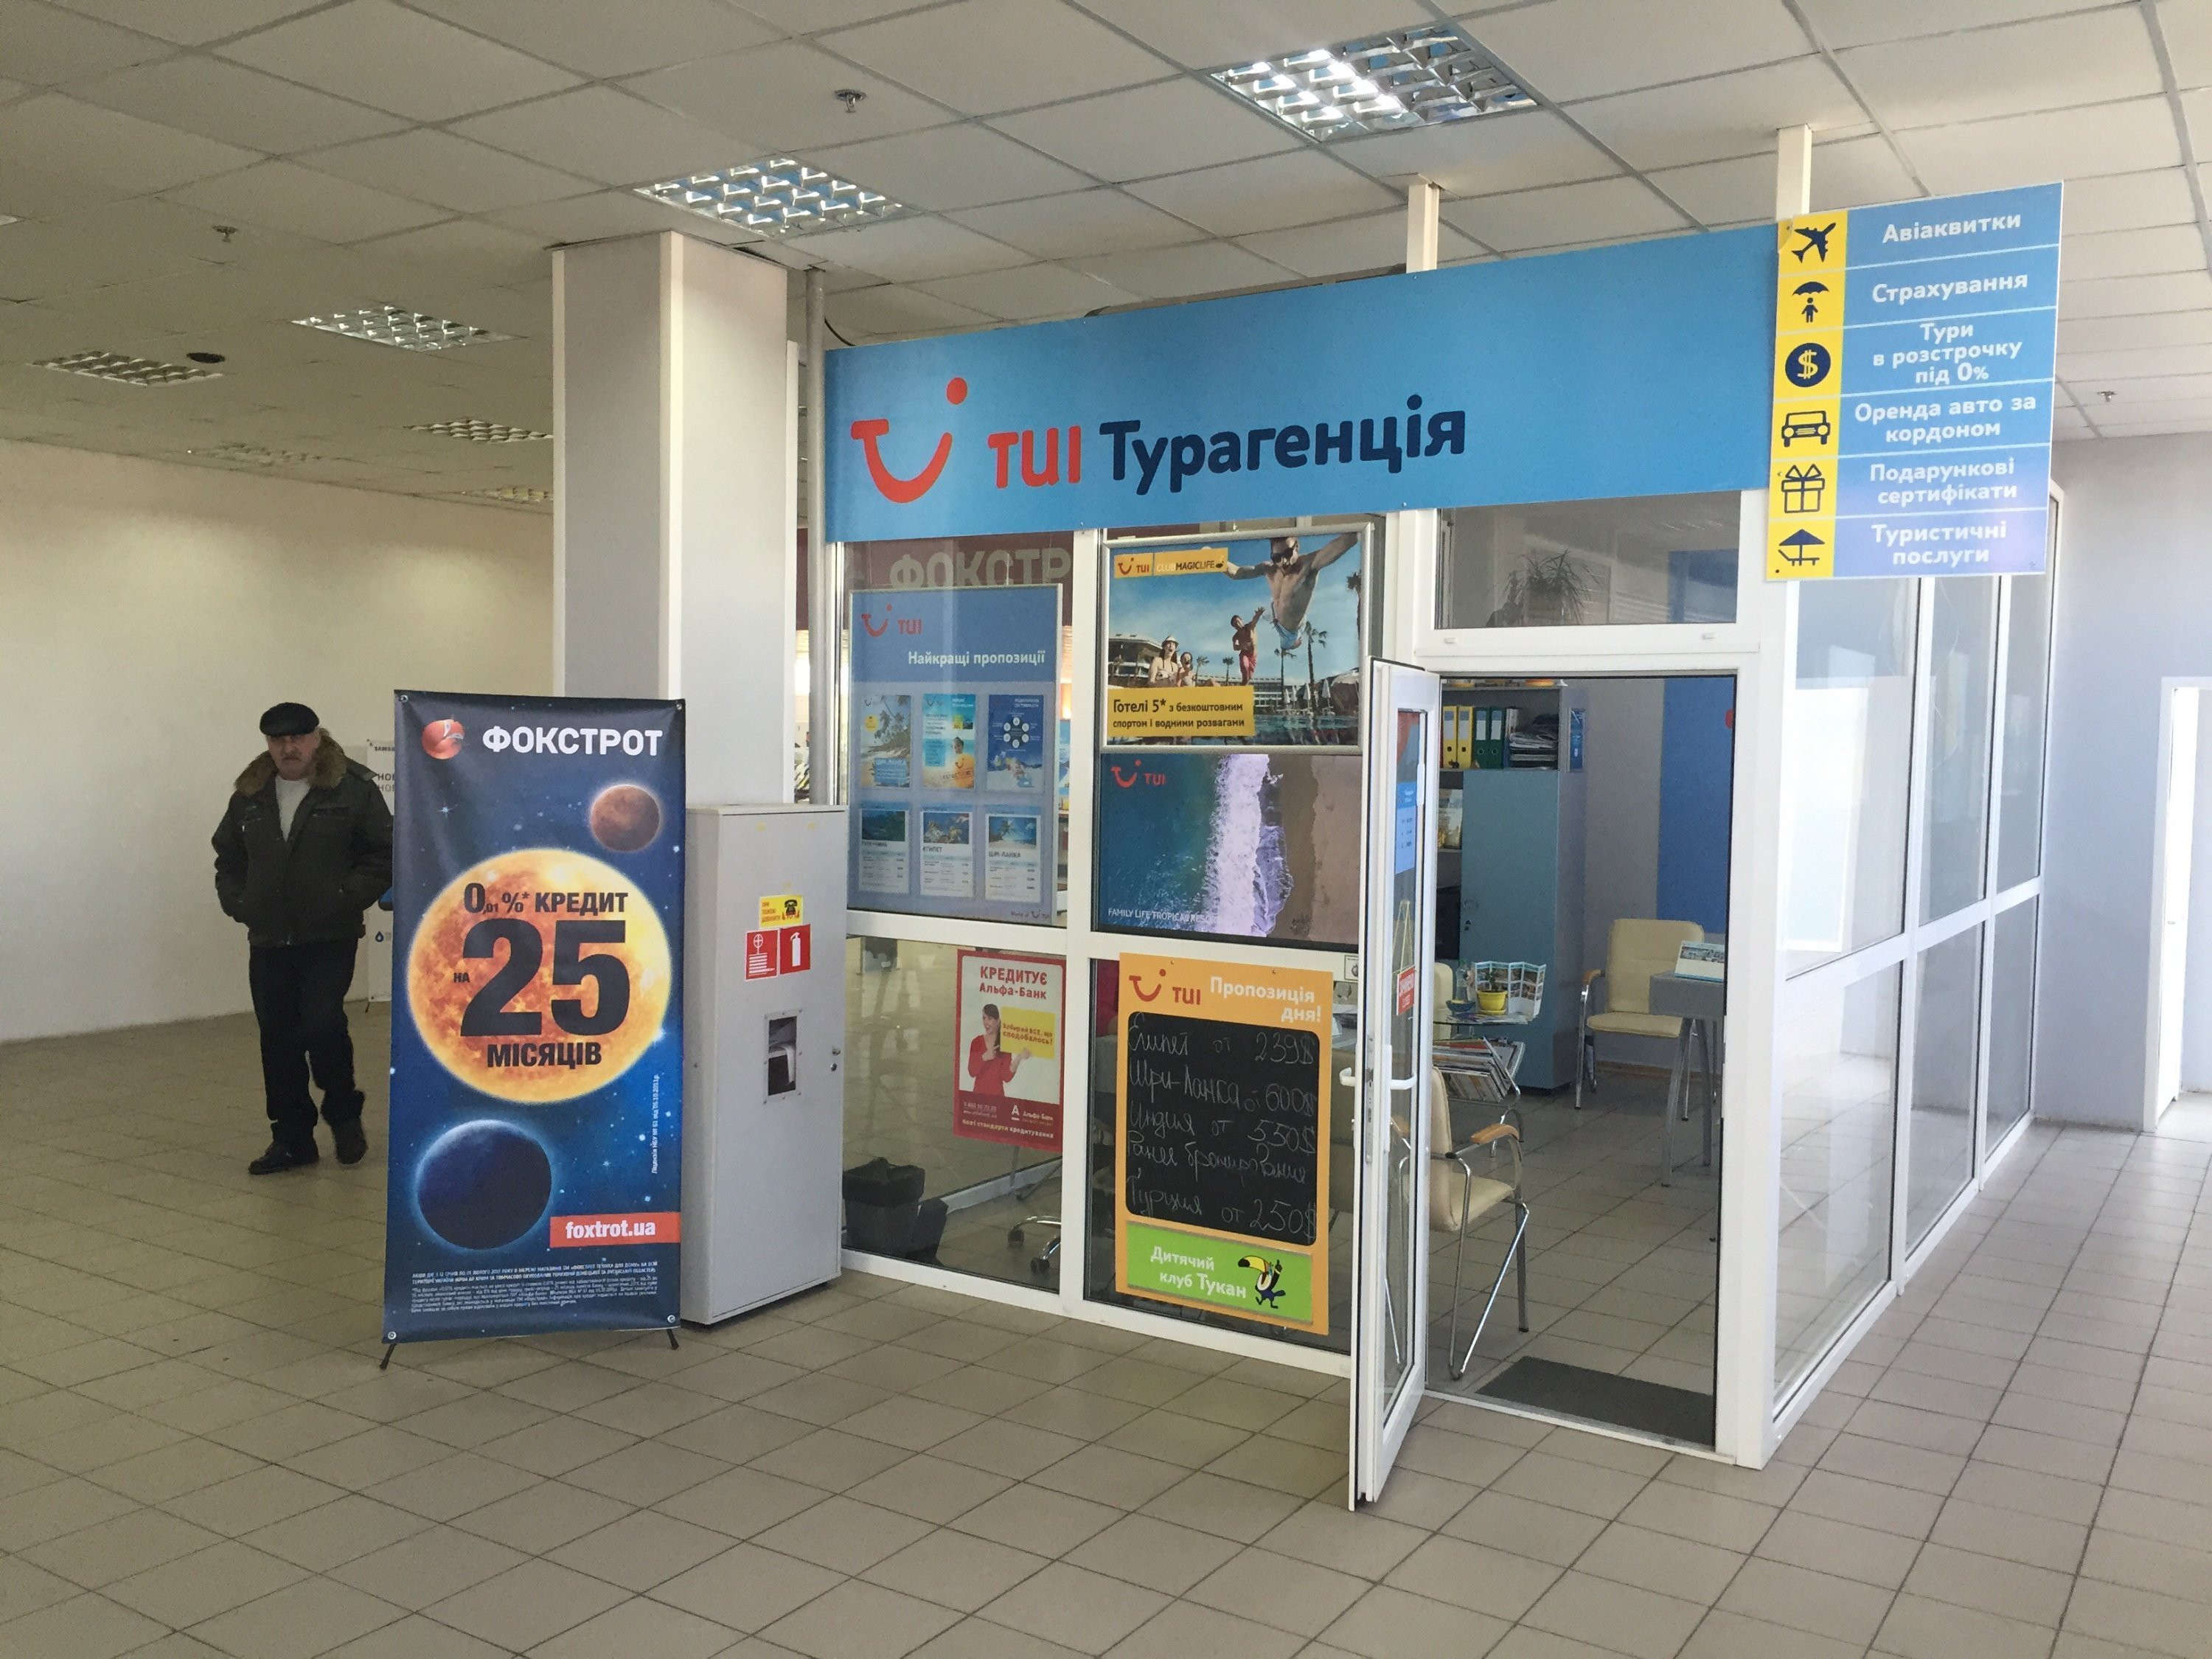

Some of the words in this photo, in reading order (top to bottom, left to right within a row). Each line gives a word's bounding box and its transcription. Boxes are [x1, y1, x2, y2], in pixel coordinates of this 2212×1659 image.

[1882, 214, 2021, 244] Авіаквитки
[1872, 274, 2028, 305] Страхування
[1920, 322, 1974, 345] Тури
[1873, 352, 1884, 366] в
[1893, 341, 2023, 370] розстрочку
[1916, 367, 1950, 386] під
[1958, 362, 1989, 381] 0%
[1854, 400, 1941, 425] Оренда
[1949, 398, 2003, 417] авто
[2011, 396, 2037, 411] за
[1099, 393, 1465, 495] Турагенція
[1885, 422, 2000, 445] кордоном
[987, 425, 1081, 489] TUI
[1870, 458, 2014, 484] Подарункові
[1877, 481, 2017, 507] сертифікати
[1871, 521, 2006, 545] Туристичні
[1136, 565, 1150, 574] TUI
[1892, 549, 1989, 568] послуги
[898, 619, 922, 634] TUI
[908, 650, 970, 667] Найкращі
[974, 650, 1046, 667] пропозиції
[1113, 699, 1148, 713] Готелі
[1176, 702, 1243, 713] безкоштовним
[1113, 720, 1147, 730] спортом
[1155, 720, 1194, 729] водними
[1197, 718, 1245, 730] розвагами
[483, 726, 663, 757] ФОКСТРОТ
[1144, 773, 1167, 785] TUI
[535, 892, 628, 916] КРЕДИТ
[1108, 908, 1133, 917] FAMILY
[1135, 909, 1151, 919] LIFE
[1189, 914, 1216, 922] RESO
[453, 973, 470, 983] НА
[460, 917, 630, 1037] 25
[980, 966, 1047, 985] КРЕДИТУЄ
[979, 982, 1046, 999] Альфа-Банк
[1172, 987, 1200, 1005] TUI
[1210, 976, 1315, 1004] Пропозиція
[1281, 1006, 1321, 1023] дня!
[487, 1042, 602, 1069] МІСЯЦІВ
[1221, 1207, 1245, 1222] от
[566, 1220, 655, 1239] foxtrot.ua
[1150, 1246, 1214, 1270] Дитячий
[1160, 1271, 1192, 1288] клуб
[1196, 1272, 1246, 1299] Тукан
